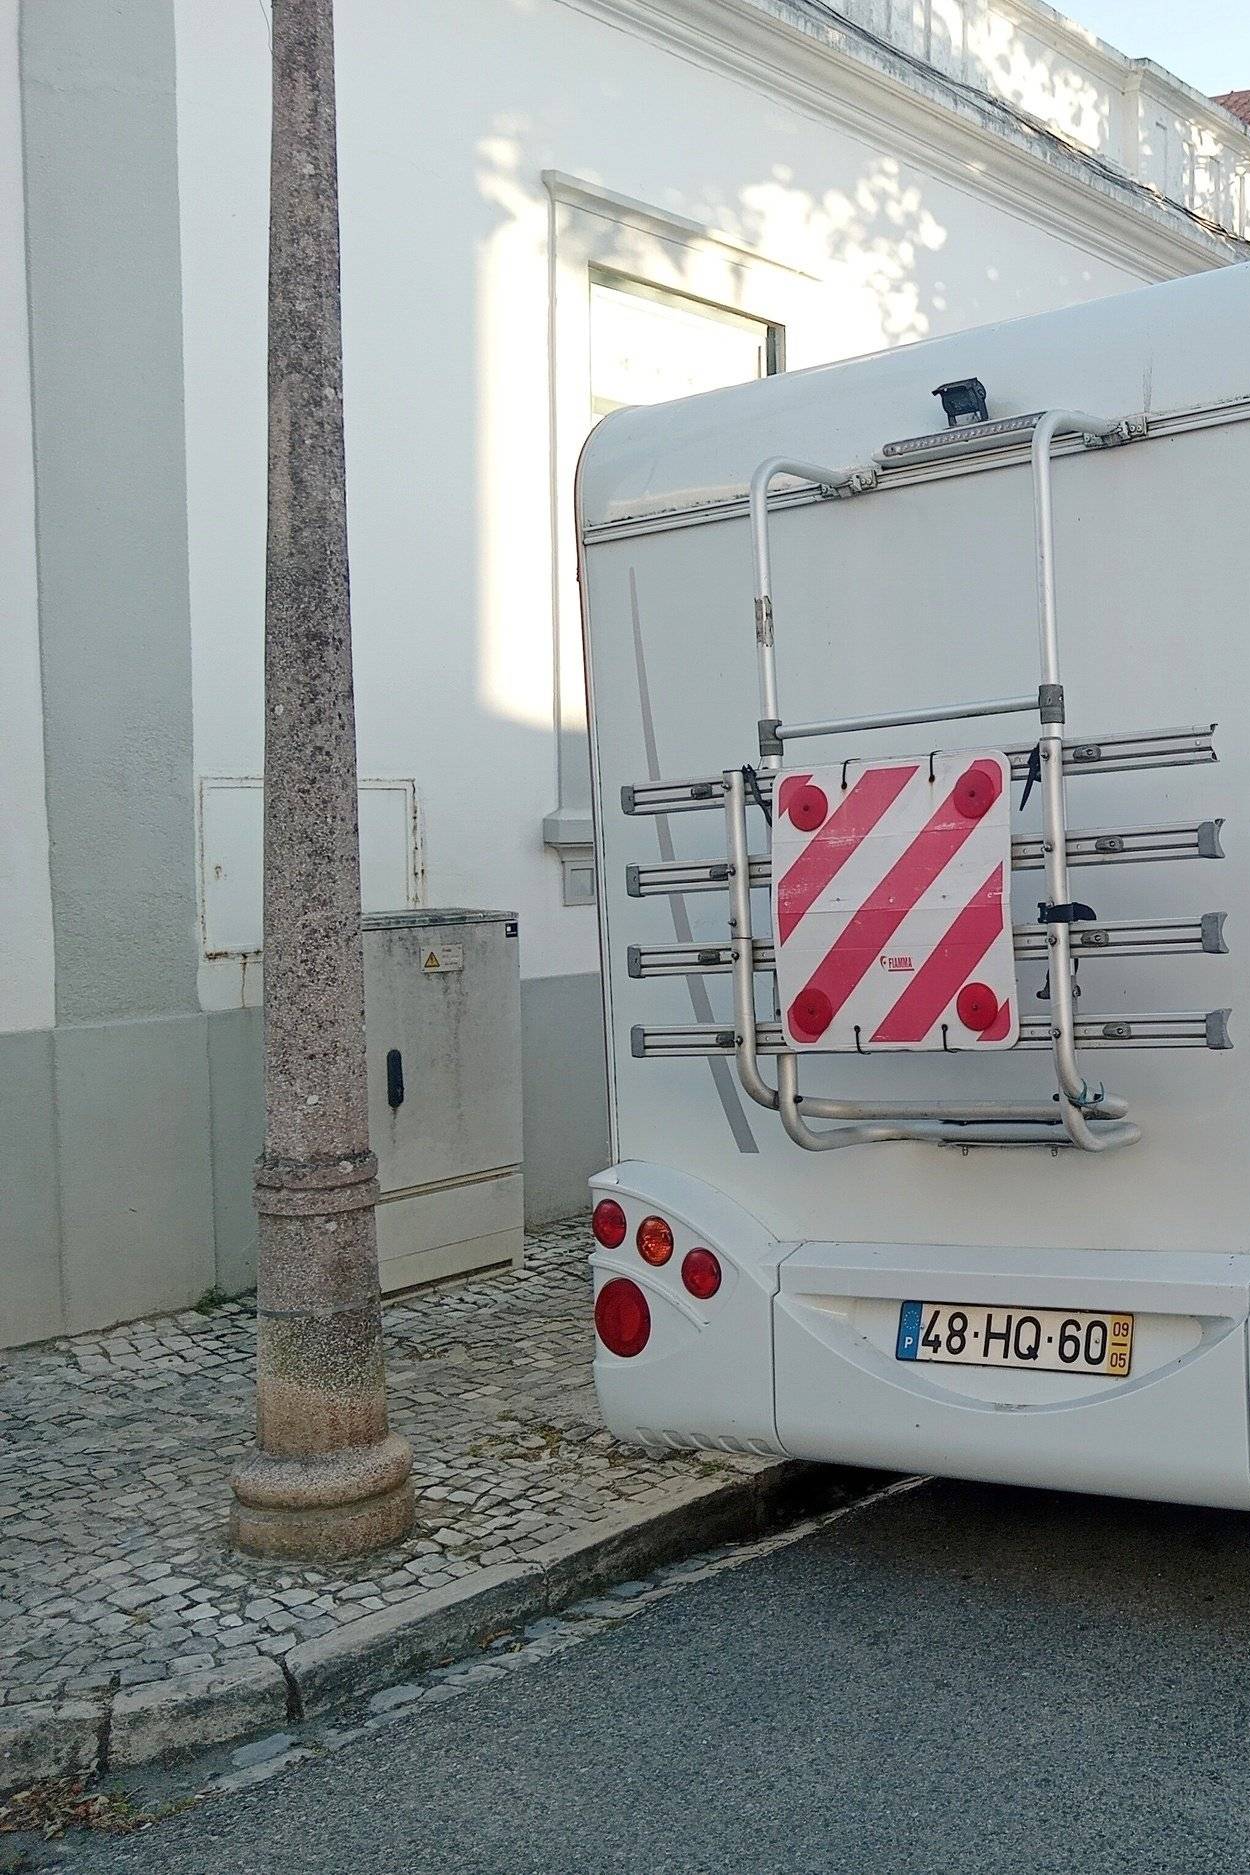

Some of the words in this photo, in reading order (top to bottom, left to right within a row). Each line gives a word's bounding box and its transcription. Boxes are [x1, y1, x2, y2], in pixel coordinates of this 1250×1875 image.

[1112, 1321, 1129, 1338] 09
[904, 1337, 913, 1348] P
[1110, 1352, 1127, 1368] 05
